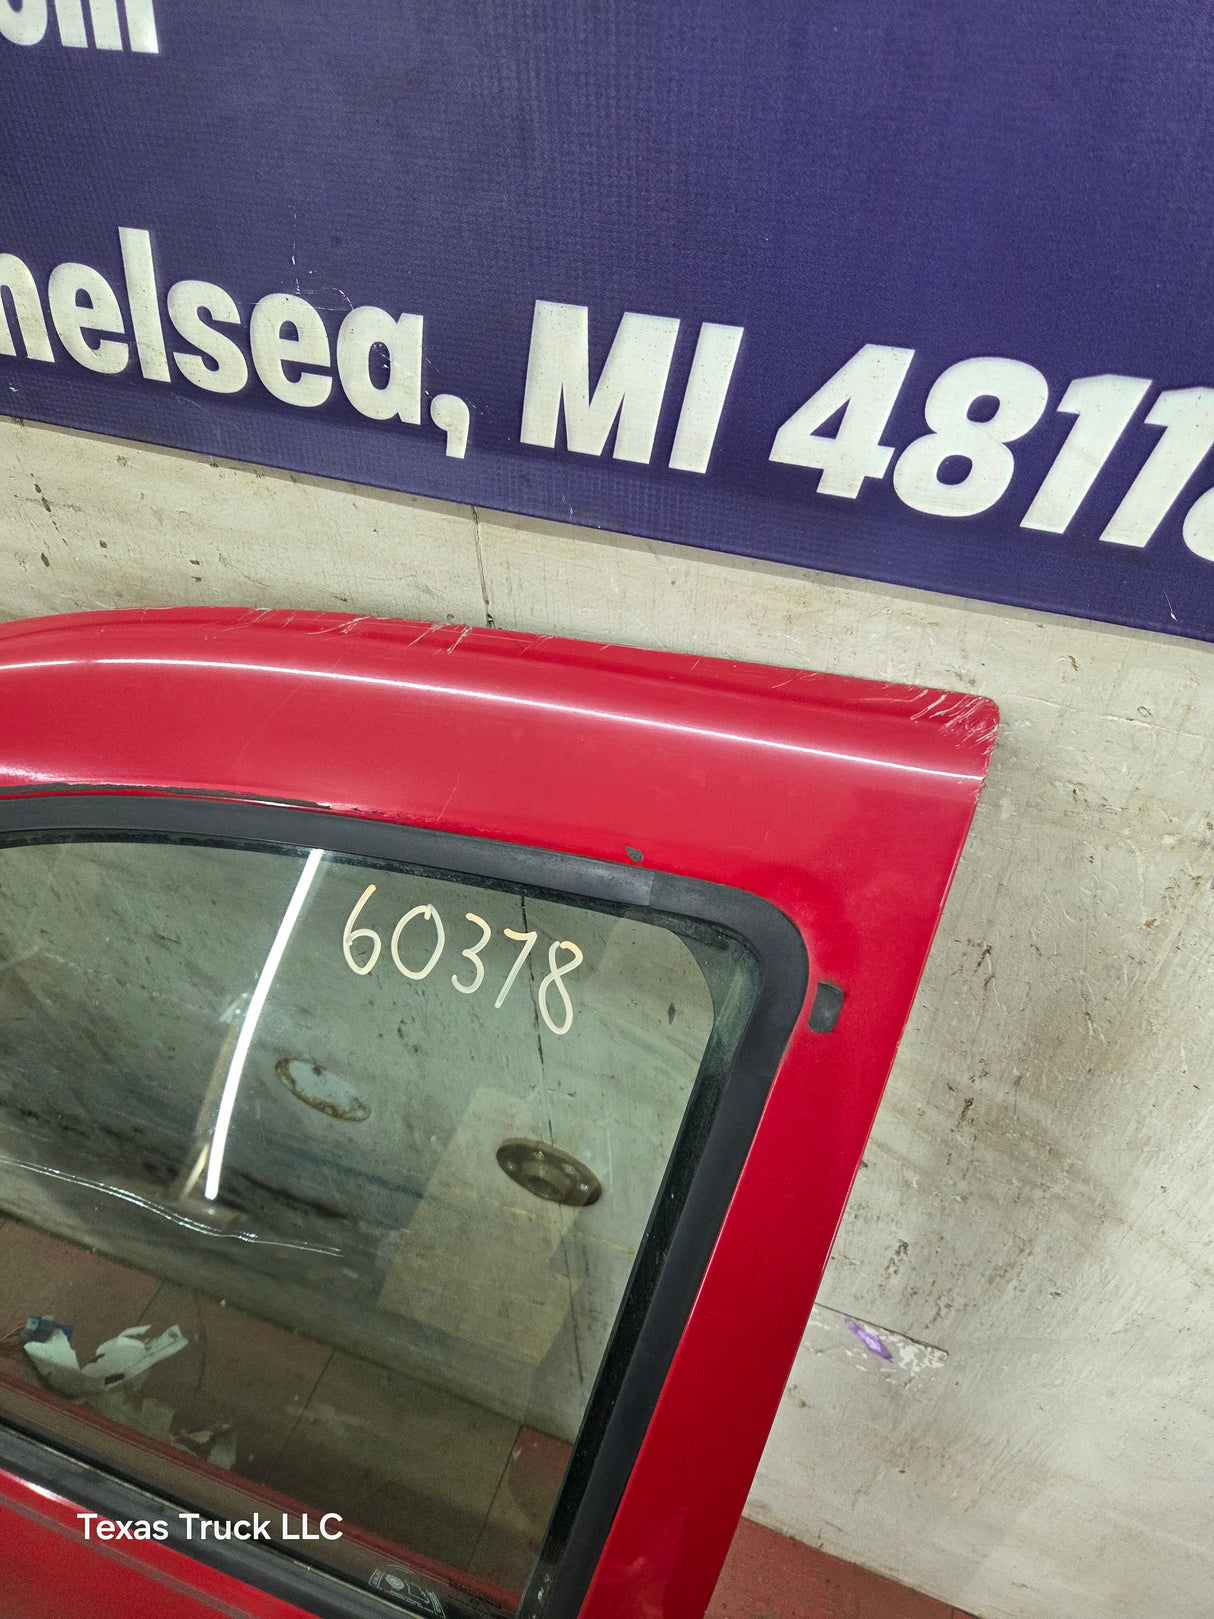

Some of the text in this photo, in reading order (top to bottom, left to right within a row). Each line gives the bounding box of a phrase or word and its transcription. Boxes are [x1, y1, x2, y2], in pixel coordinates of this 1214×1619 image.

[520, 299, 745, 475] MI
[769, 343, 1214, 563] 4811
[342, 884, 584, 1035] 60378
